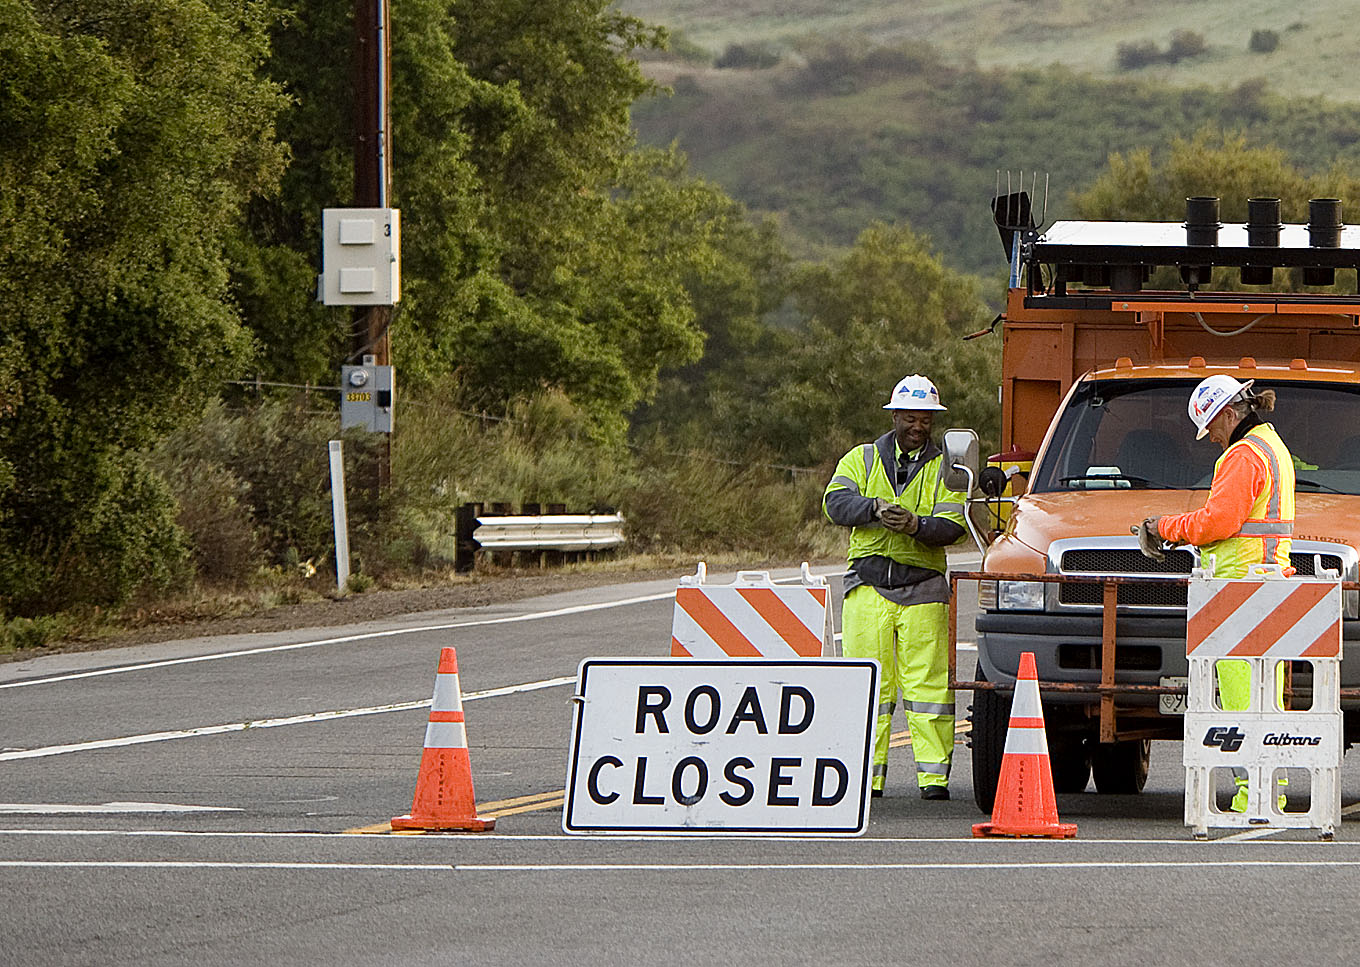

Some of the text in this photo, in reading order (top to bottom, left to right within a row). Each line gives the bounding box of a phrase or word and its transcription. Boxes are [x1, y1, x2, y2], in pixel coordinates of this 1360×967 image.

[384, 223, 391, 237] 3
[635, 685, 815, 735] ROAD
[1262, 733, 1322, 746] Caltrans
[587, 755, 849, 807] CLOSED
[1017, 760, 1025, 812] CALTRANS
